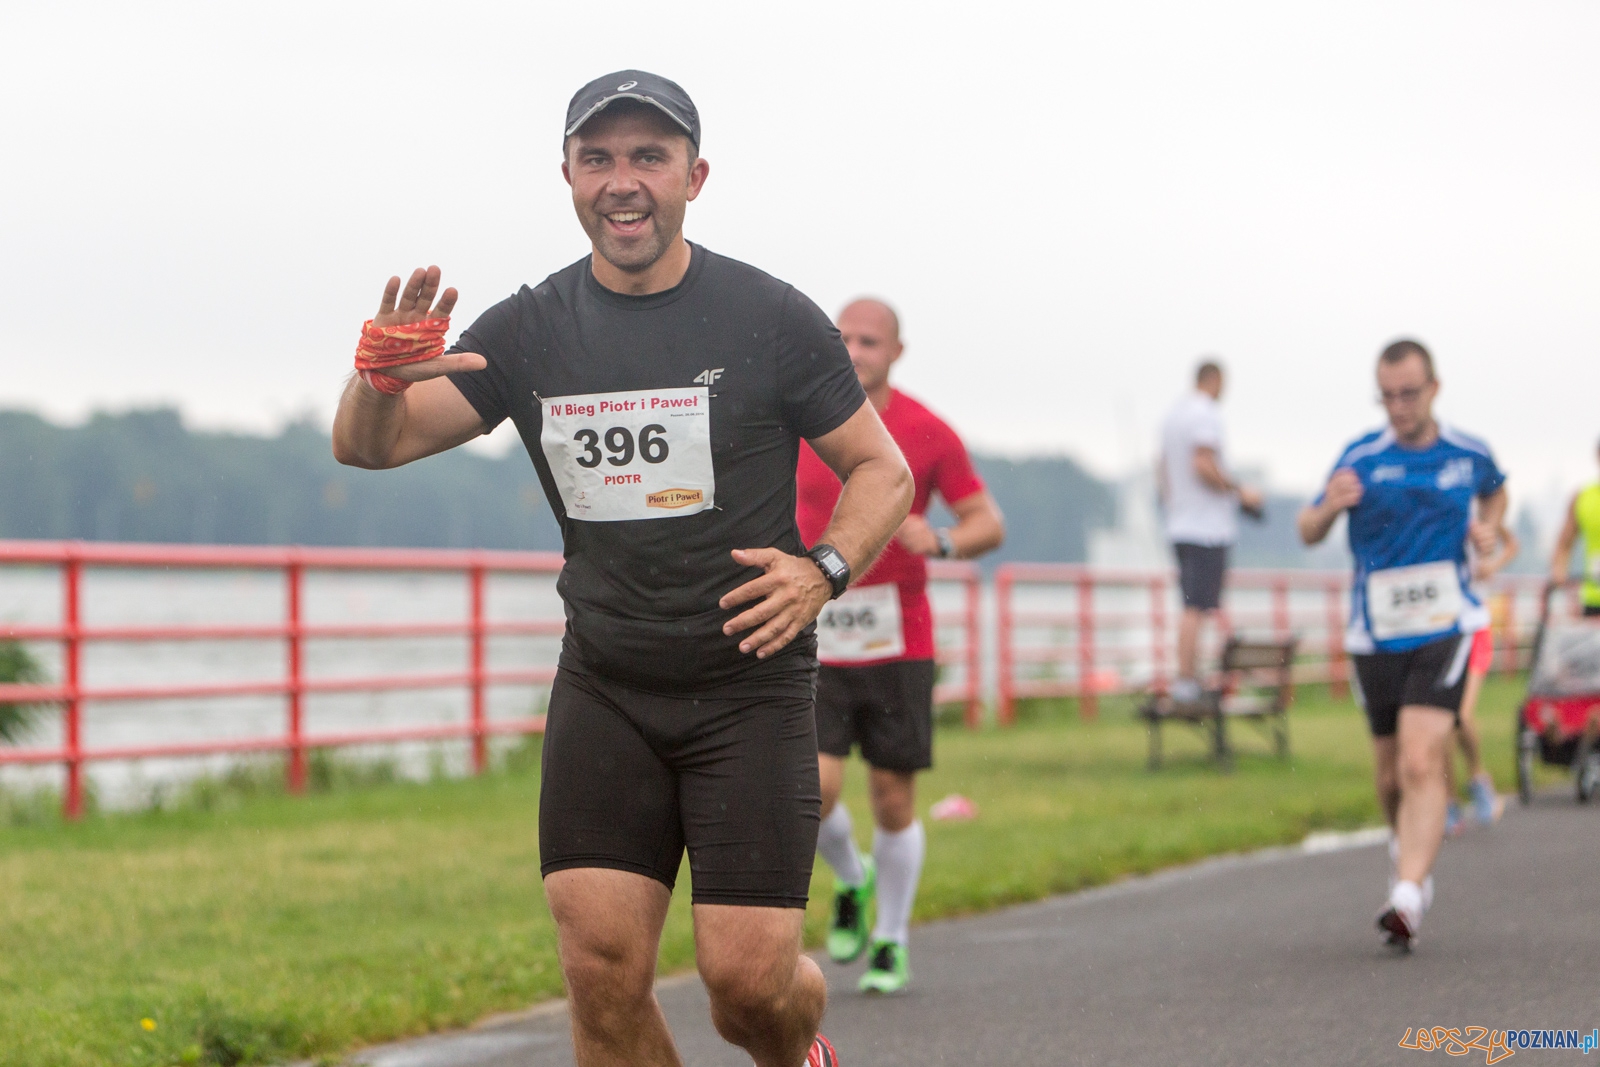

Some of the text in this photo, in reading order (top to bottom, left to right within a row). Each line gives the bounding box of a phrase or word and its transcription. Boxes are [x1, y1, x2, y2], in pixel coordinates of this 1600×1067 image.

[693, 368, 724, 385] 4F
[551, 395, 698, 417] IV Bieg Piotr i Paweł
[573, 423, 669, 469] 396
[604, 474, 642, 486] PIOTR
[648, 495, 669, 503] Piotr
[676, 492, 700, 501] Paweł
[821, 608, 876, 631] 496
